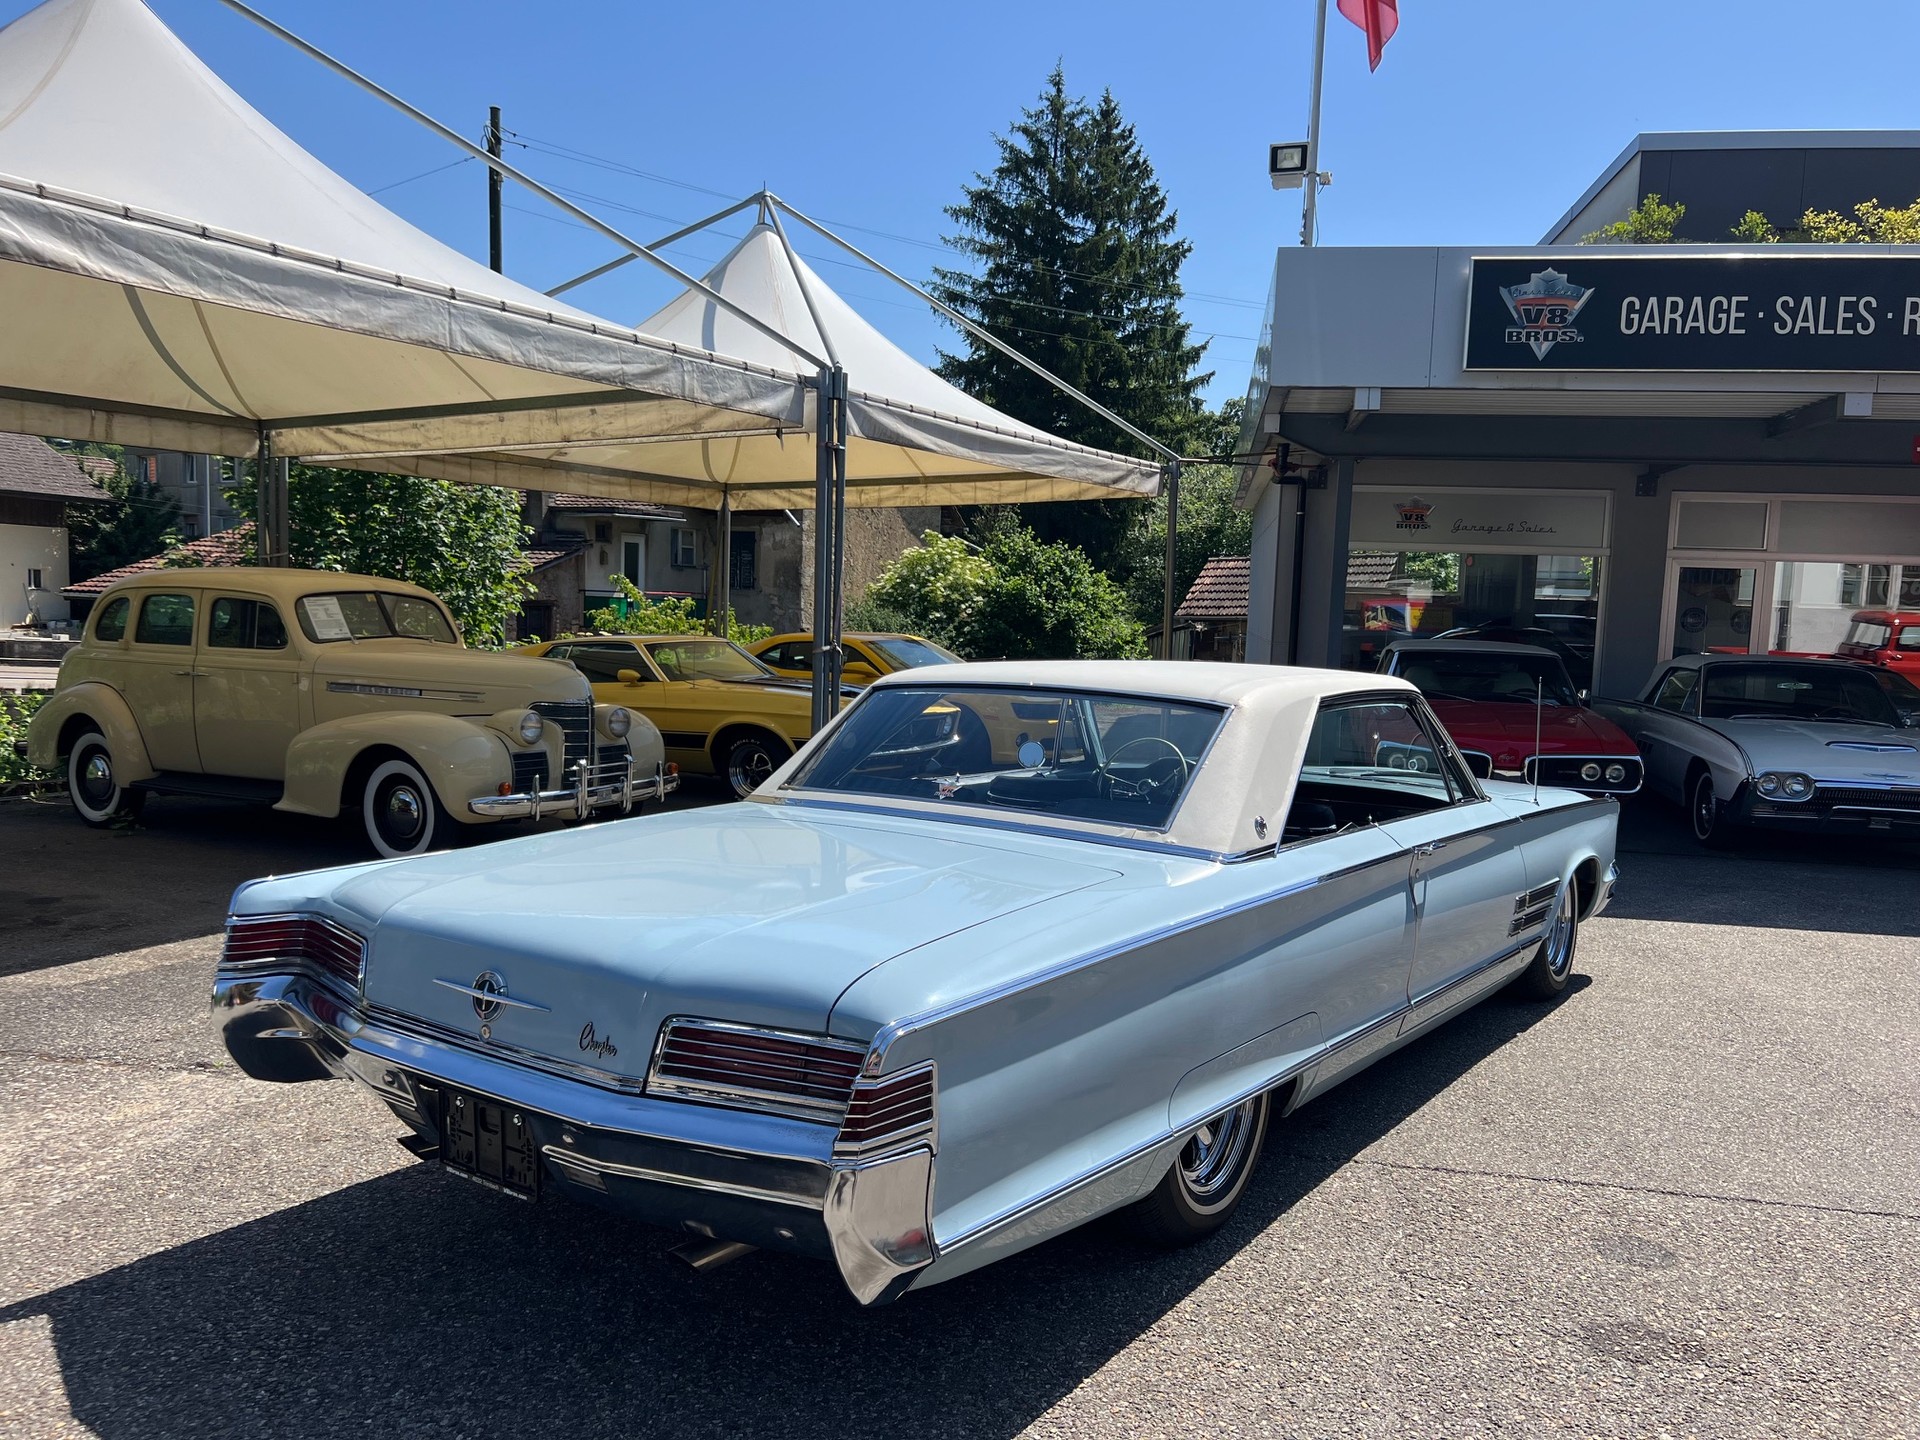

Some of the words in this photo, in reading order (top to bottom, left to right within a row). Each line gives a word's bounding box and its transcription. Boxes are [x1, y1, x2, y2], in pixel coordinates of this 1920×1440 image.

[1520, 305, 1569, 326] V8
[1620, 296, 1748, 335] GARAGE
[1773, 296, 1877, 335] SALES
[1505, 329, 1584, 343] BROS.
[1403, 513, 1425, 521] V8
[1451, 519, 1503, 535] Garage
[1507, 523, 1514, 533] &
[1516, 521, 1557, 533] Sales
